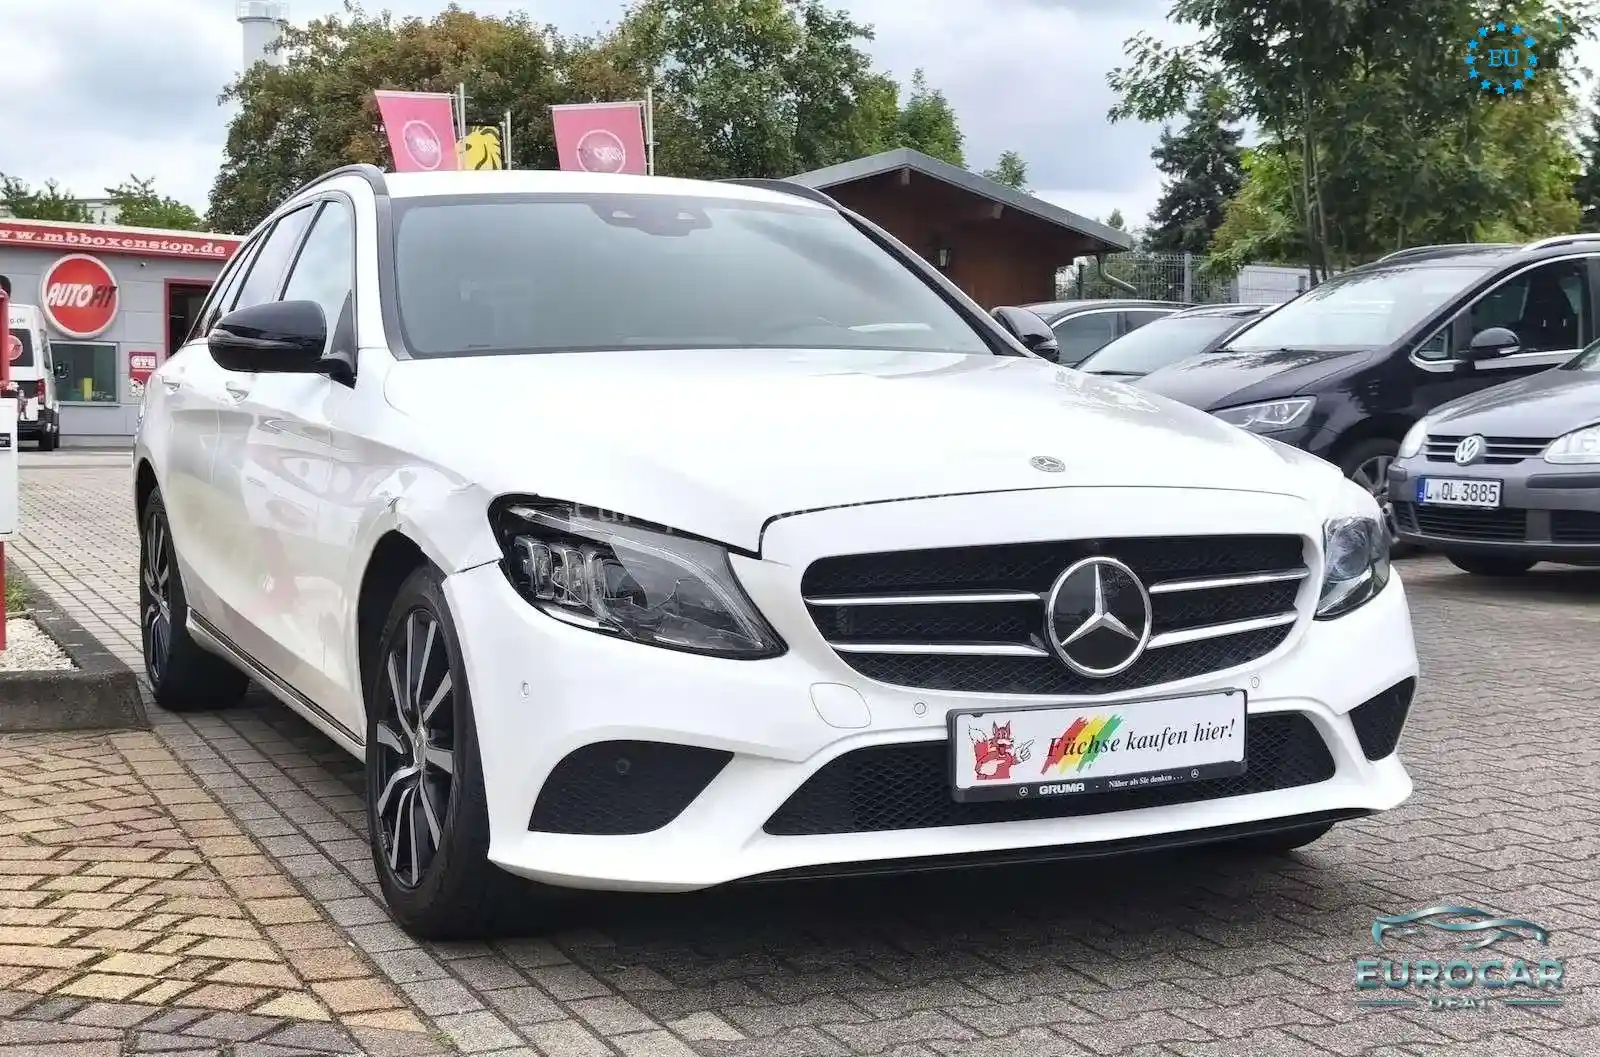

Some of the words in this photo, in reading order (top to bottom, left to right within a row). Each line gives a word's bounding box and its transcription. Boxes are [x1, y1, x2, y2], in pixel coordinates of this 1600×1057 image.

[1460, 483, 1498, 503] 3885
[1047, 734, 1121, 757] Füchse
[1126, 727, 1187, 752] kaufen
[1193, 718, 1235, 742] hier!
[1039, 782, 1085, 795] GRUMA
[1129, 777, 1139, 786] als
[1140, 776, 1149, 785] Sie
